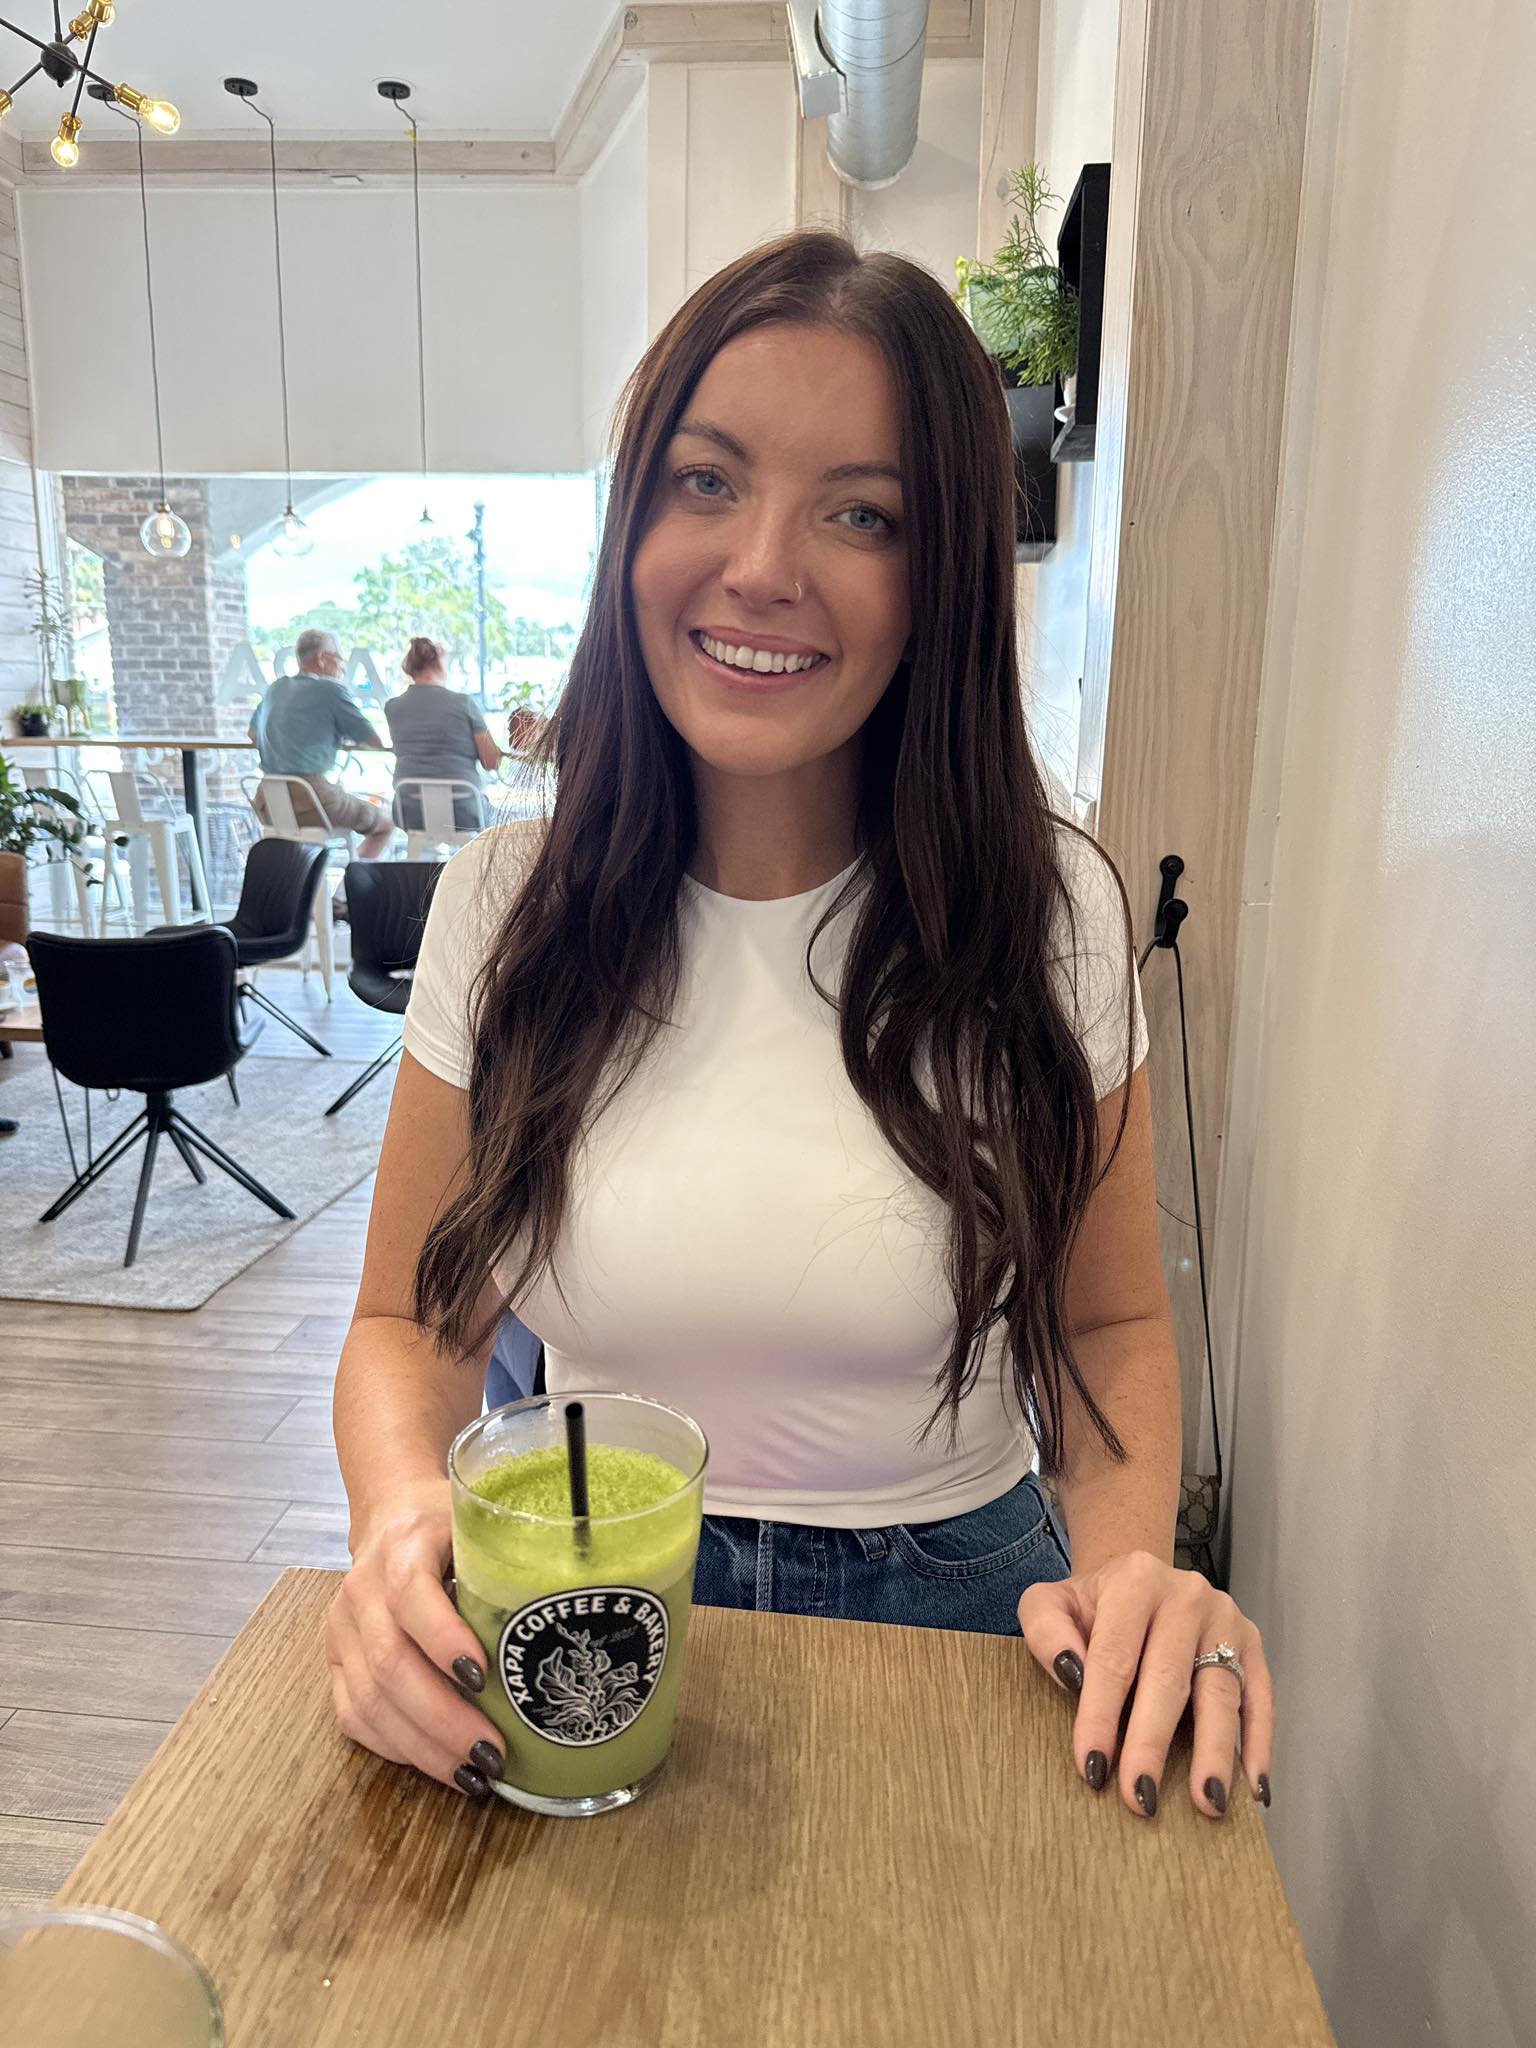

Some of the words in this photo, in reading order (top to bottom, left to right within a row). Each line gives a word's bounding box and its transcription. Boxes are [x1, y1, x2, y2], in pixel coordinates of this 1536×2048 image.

[515, 1595, 606, 1641] COFFEE
[613, 1596, 631, 1614] &
[633, 1602, 664, 1683] BAKERY
[506, 1644, 533, 1704] XAPA
